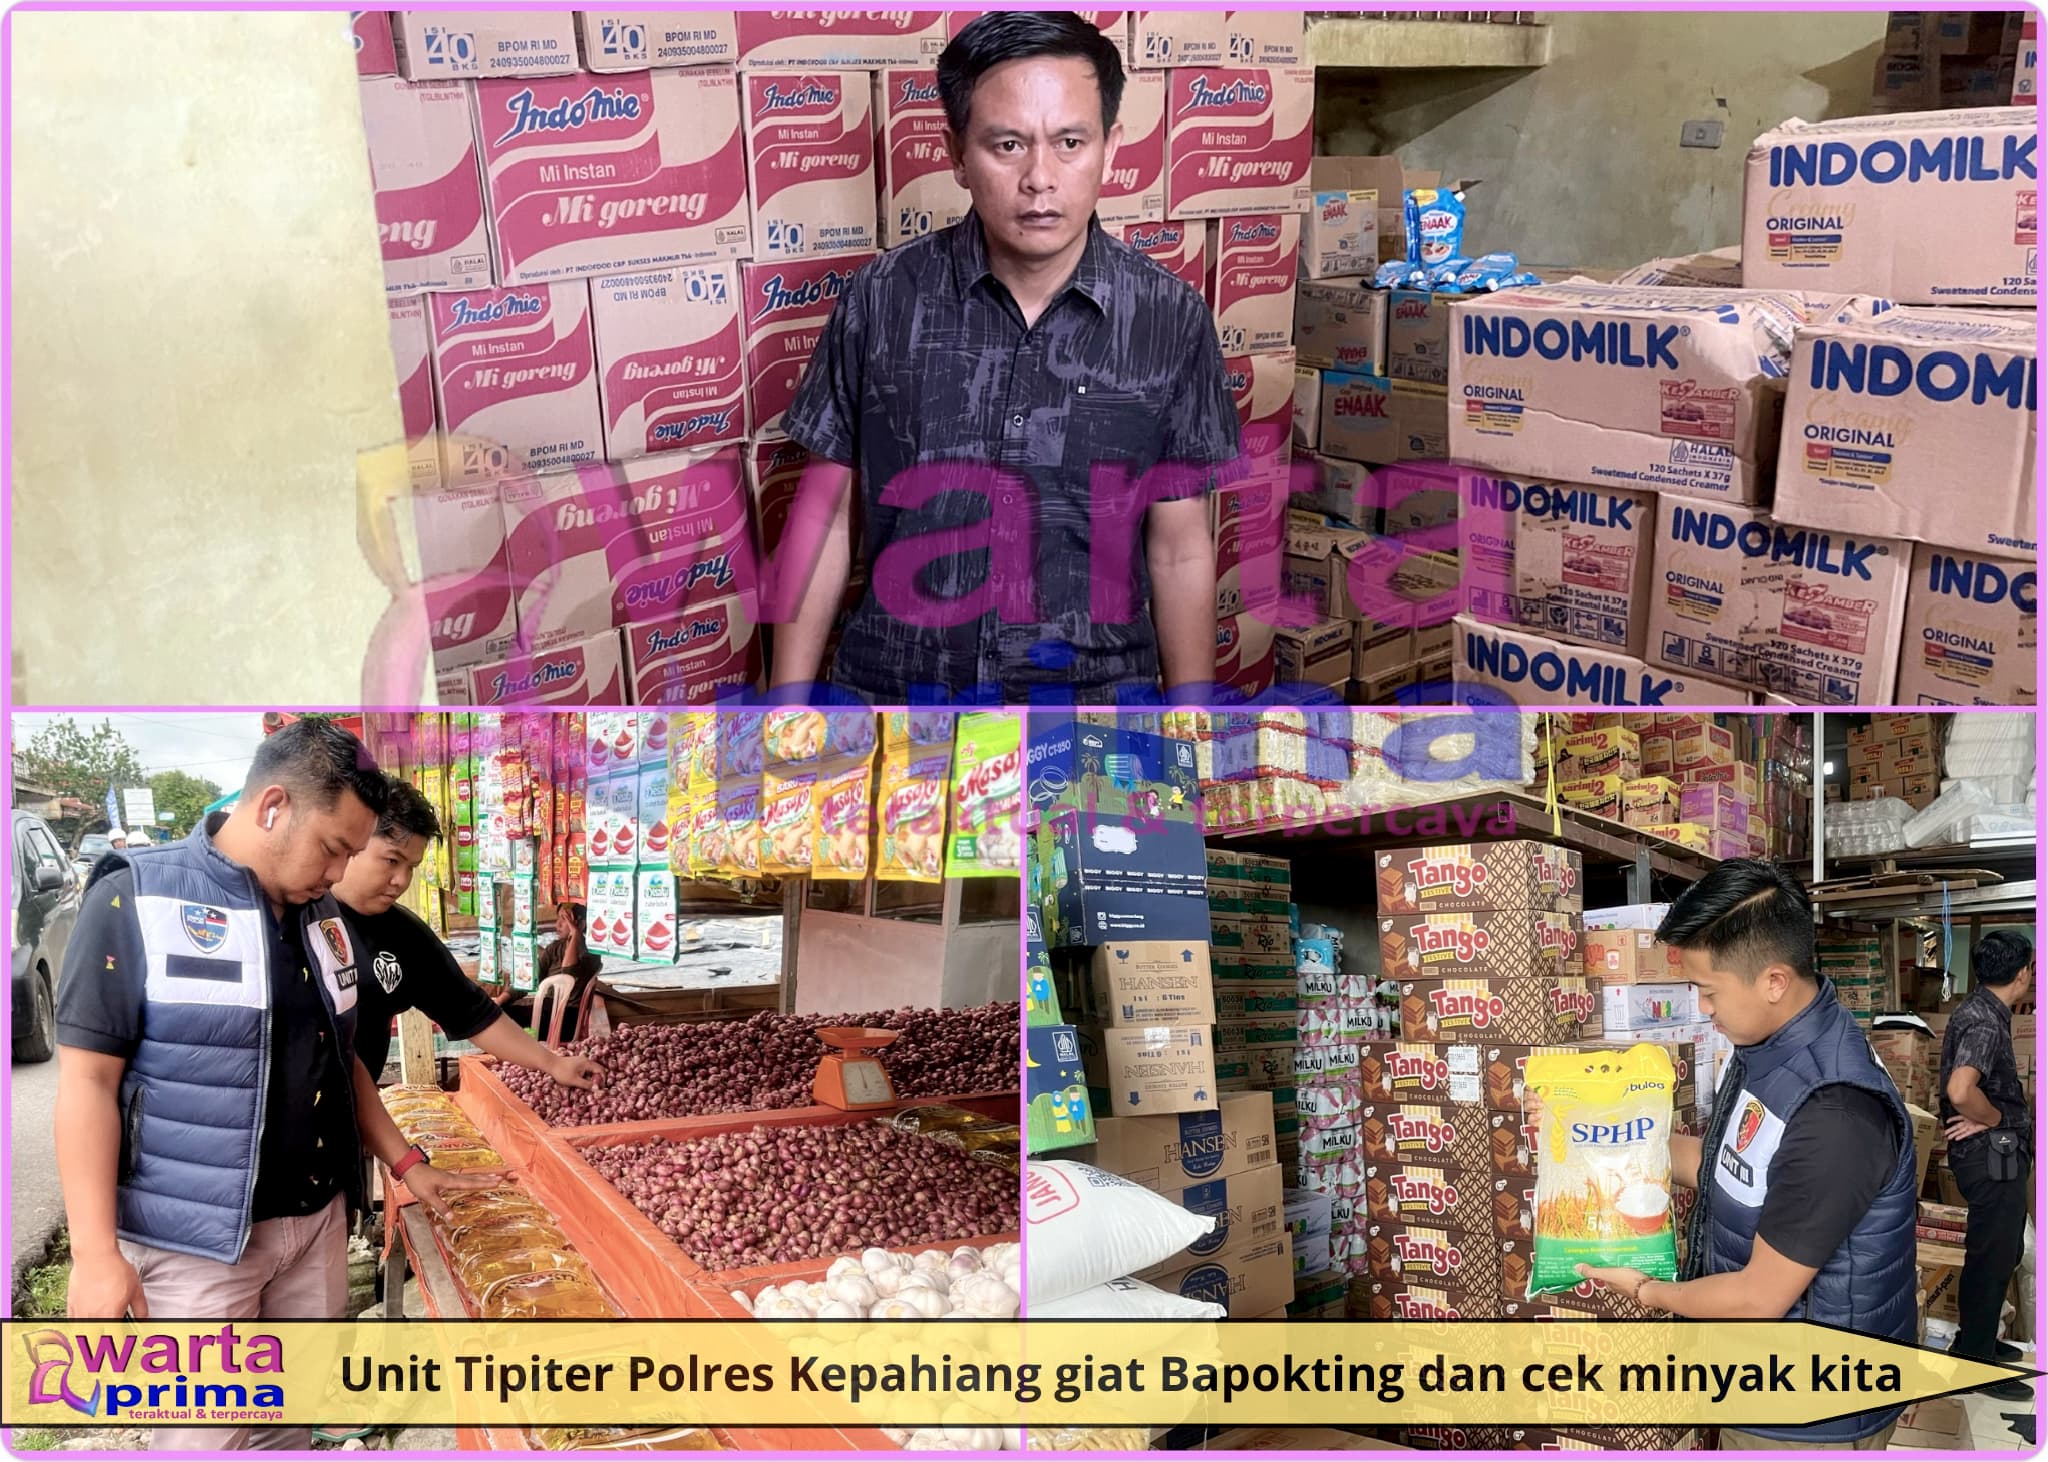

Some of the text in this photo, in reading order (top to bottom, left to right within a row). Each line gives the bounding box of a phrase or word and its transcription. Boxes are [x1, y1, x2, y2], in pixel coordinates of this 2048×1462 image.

[497, 39, 558, 52] BPOM RI MD
[602, 25, 646, 54] 40
[665, 30, 717, 42] BPOM RI MD
[425, 33, 477, 64] 40
[452, 63, 478, 71] BKS
[778, 129, 819, 140] Mi Instan
[1202, 132, 1247, 145] Mi Instan
[906, 142, 930, 160] Mi
[771, 151, 861, 172] Mi goreng
[1198, 157, 1293, 182] Mi goreng
[539, 163, 616, 183] Mi Instan
[542, 191, 708, 228] Mi goreng
[901, 211, 933, 235] 40
[1766, 217, 1844, 231] ORIGINAL
[768, 223, 804, 249] 40
[1231, 273, 1288, 288] Mi goreng
[2002, 277, 2021, 286] 120
[472, 341, 525, 356] Mi Instan
[1464, 315, 1679, 370] INDOMILK
[464, 363, 577, 390] Mi goreng
[622, 357, 726, 382] Mi goreng
[672, 385, 718, 399] Mi Instan
[1464, 385, 1525, 401] ORIGINAL
[1334, 395, 1389, 418] ENAAK
[1804, 424, 1895, 449] ORIGINAL
[529, 440, 585, 457] BPOM RI MD
[1591, 466, 1730, 492] Sweetened Condensed Creamer
[1649, 464, 1731, 483] 120 Sachets X 37g
[557, 485, 664, 532] goreng
[1470, 476, 1633, 531] INDOMILK
[650, 522, 696, 544] Instan
[1672, 507, 1873, 580] INDOMILK
[1665, 571, 1725, 595] ORIGINAL
[1922, 628, 1996, 655] ORIGINAL
[678, 659, 706, 675] Instan
[1791, 644, 1830, 661] Sachets
[1841, 656, 1863, 670] 37g
[1467, 633, 1673, 706] INDOMILK
[1816, 660, 1863, 680] Creamer
[761, 787, 810, 828] Masako
[1409, 858, 1488, 897] Tango
[1439, 901, 1486, 909] CHOCOLATE
[1411, 923, 1490, 963] Tango
[1536, 920, 1577, 960] Tango
[1423, 953, 1454, 962] FESTIVE
[1441, 966, 1488, 974] CHOCOLATE
[1119, 975, 1198, 991] HANSEN
[1306, 982, 1333, 993] MILKU
[1429, 989, 1504, 1029] Tango
[1550, 987, 1594, 1023] Tango
[1346, 1016, 1373, 1028] MILKU
[1459, 1032, 1502, 1040] CHOCOLATE
[1294, 1055, 1322, 1071] MILKU
[1329, 1052, 1355, 1067] MILKU
[1124, 1060, 1205, 1080] HANSEN
[1385, 1051, 1449, 1091] Tango
[1409, 1093, 1448, 1101] CHOCOLATE
[1388, 1112, 1456, 1153] Tango
[1572, 1117, 1655, 1145] SPHP
[1164, 1131, 1238, 1164] HANSEN
[1322, 1134, 1352, 1149] MILKU
[1414, 1155, 1454, 1164] CHOCOLATE
[1721, 1152, 1741, 1177] UNIT
[1391, 1174, 1459, 1215] Tango
[1417, 1216, 1457, 1226] CHOCOLATE
[1587, 1216, 1597, 1232] 5
[1394, 1235, 1462, 1276] Tango
[1420, 1277, 1461, 1288] CHOCOLATE
[1560, 1298, 1606, 1312] CHOCOLATE
